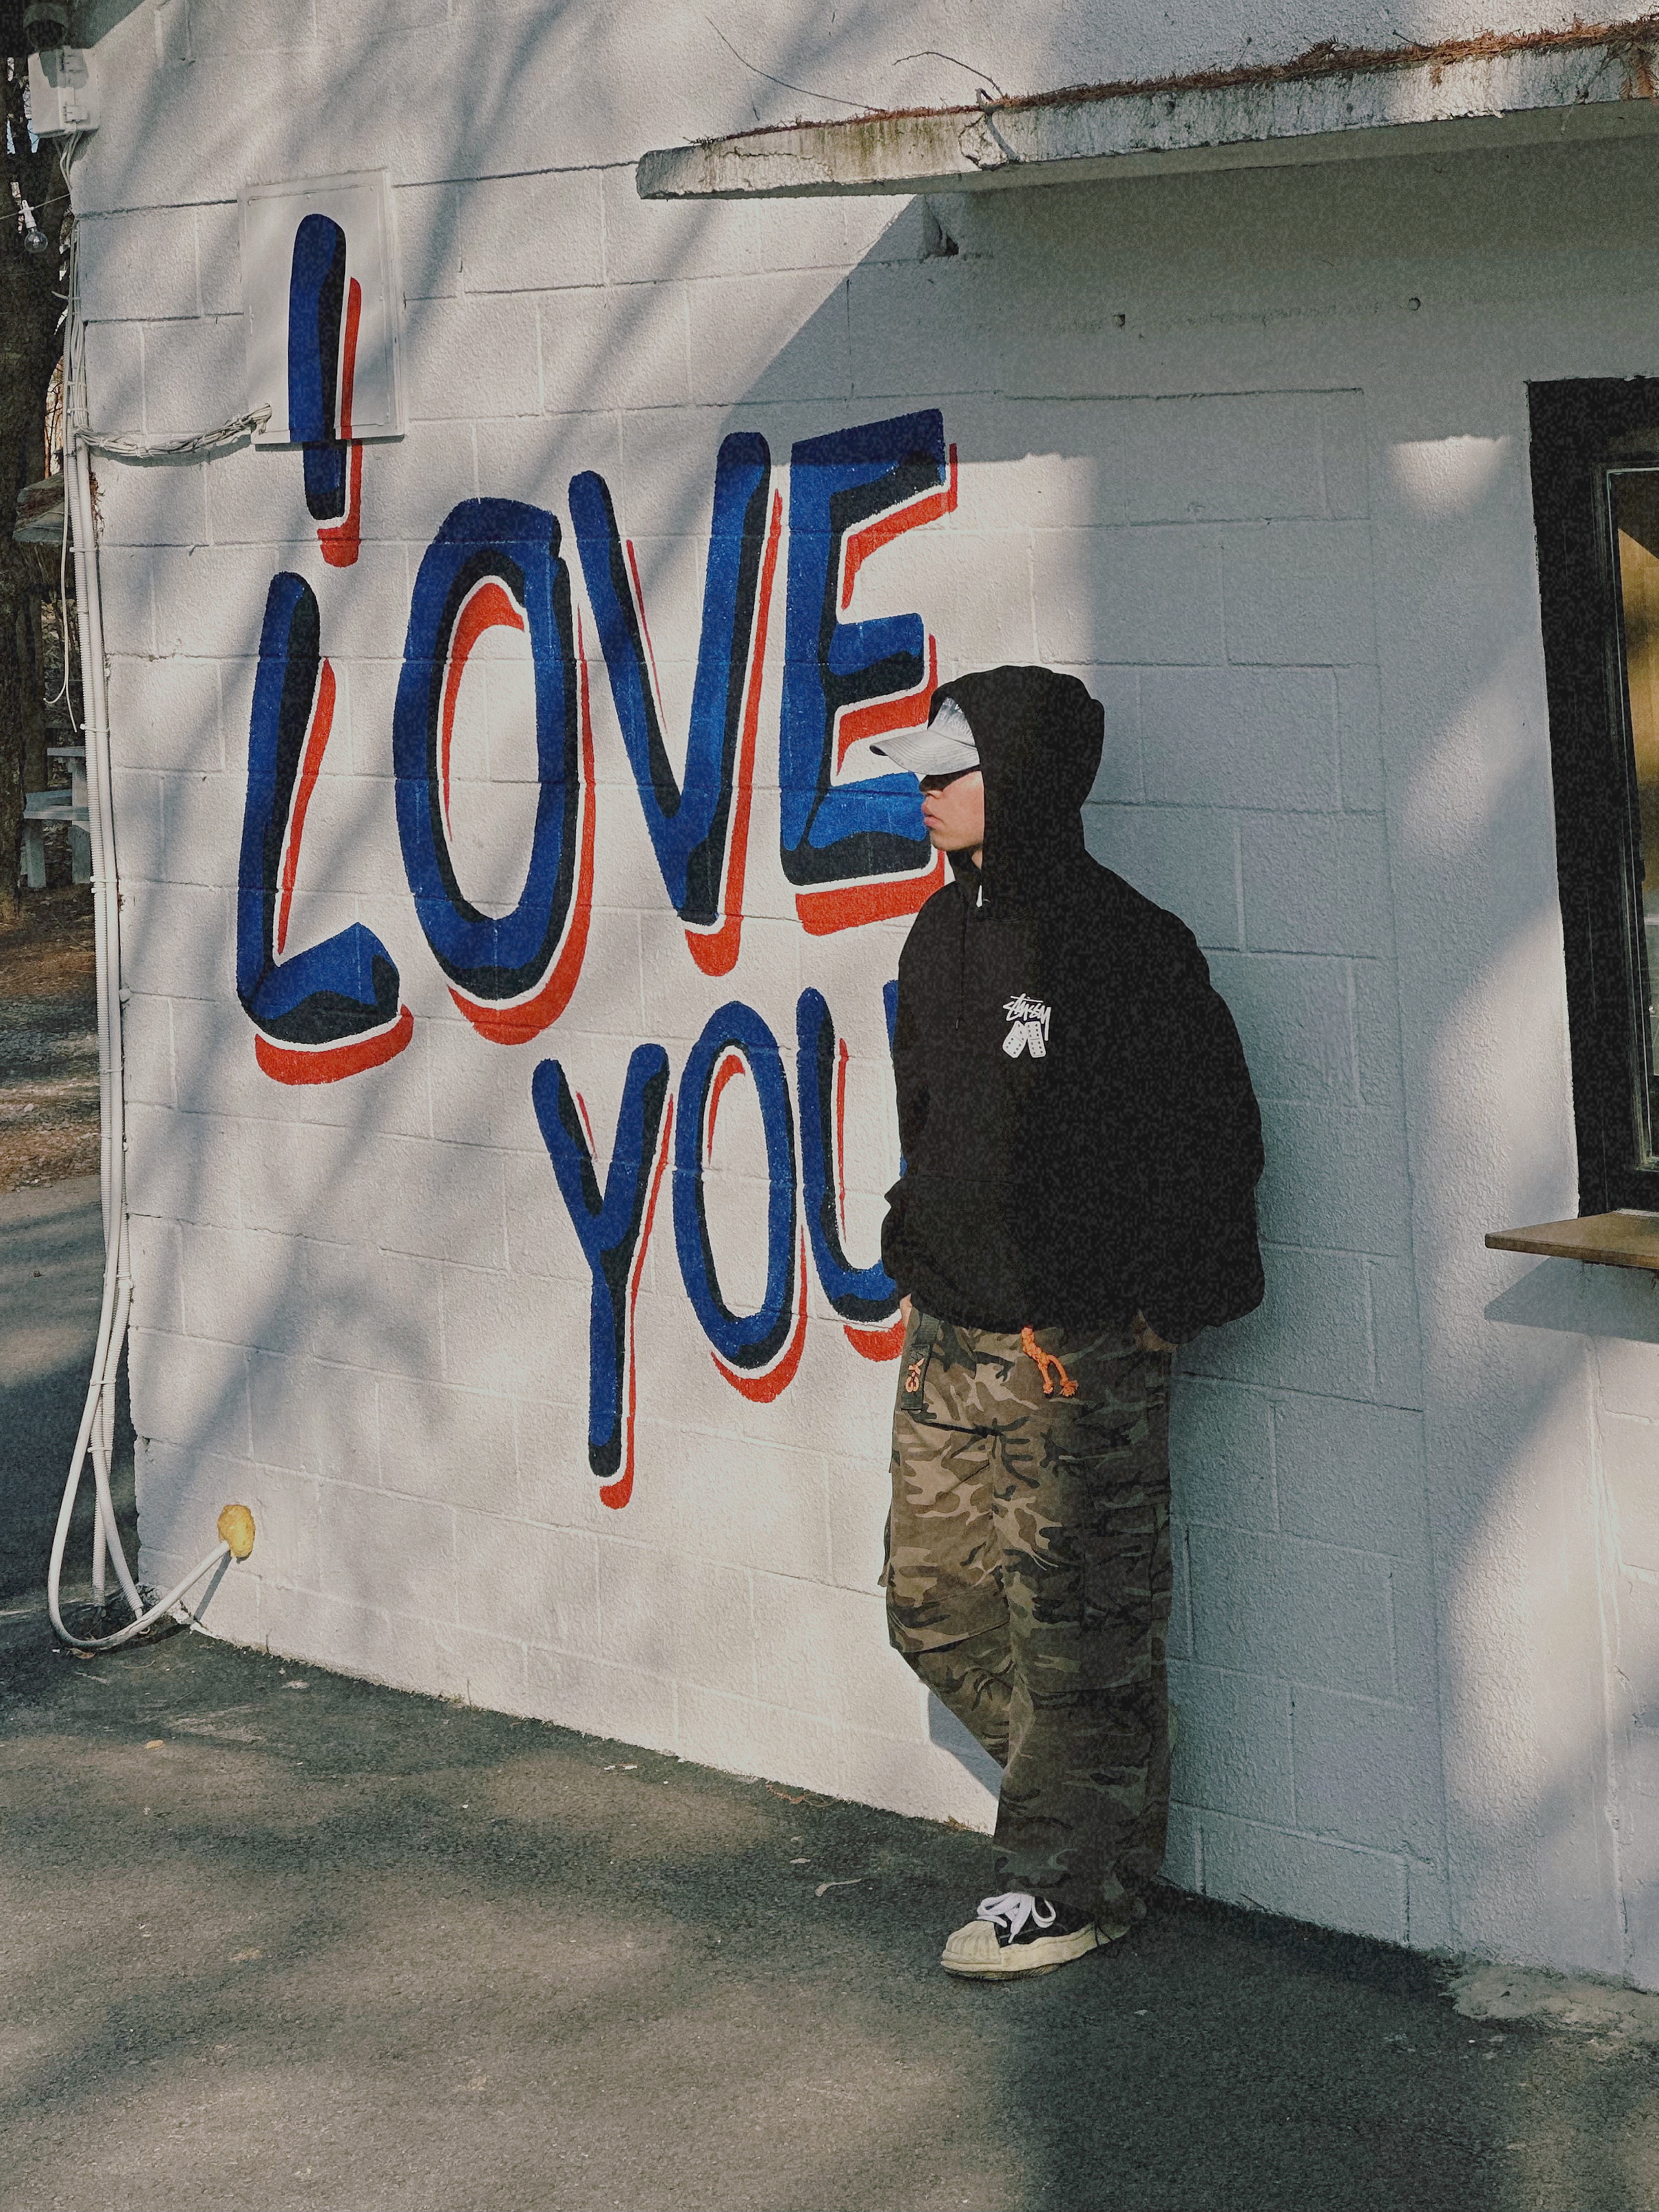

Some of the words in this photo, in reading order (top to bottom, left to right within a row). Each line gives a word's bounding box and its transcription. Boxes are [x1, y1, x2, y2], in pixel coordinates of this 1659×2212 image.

[288, 213, 363, 567] I
[237, 408, 959, 1084] LOVE
[531, 978, 906, 1509] YOU
